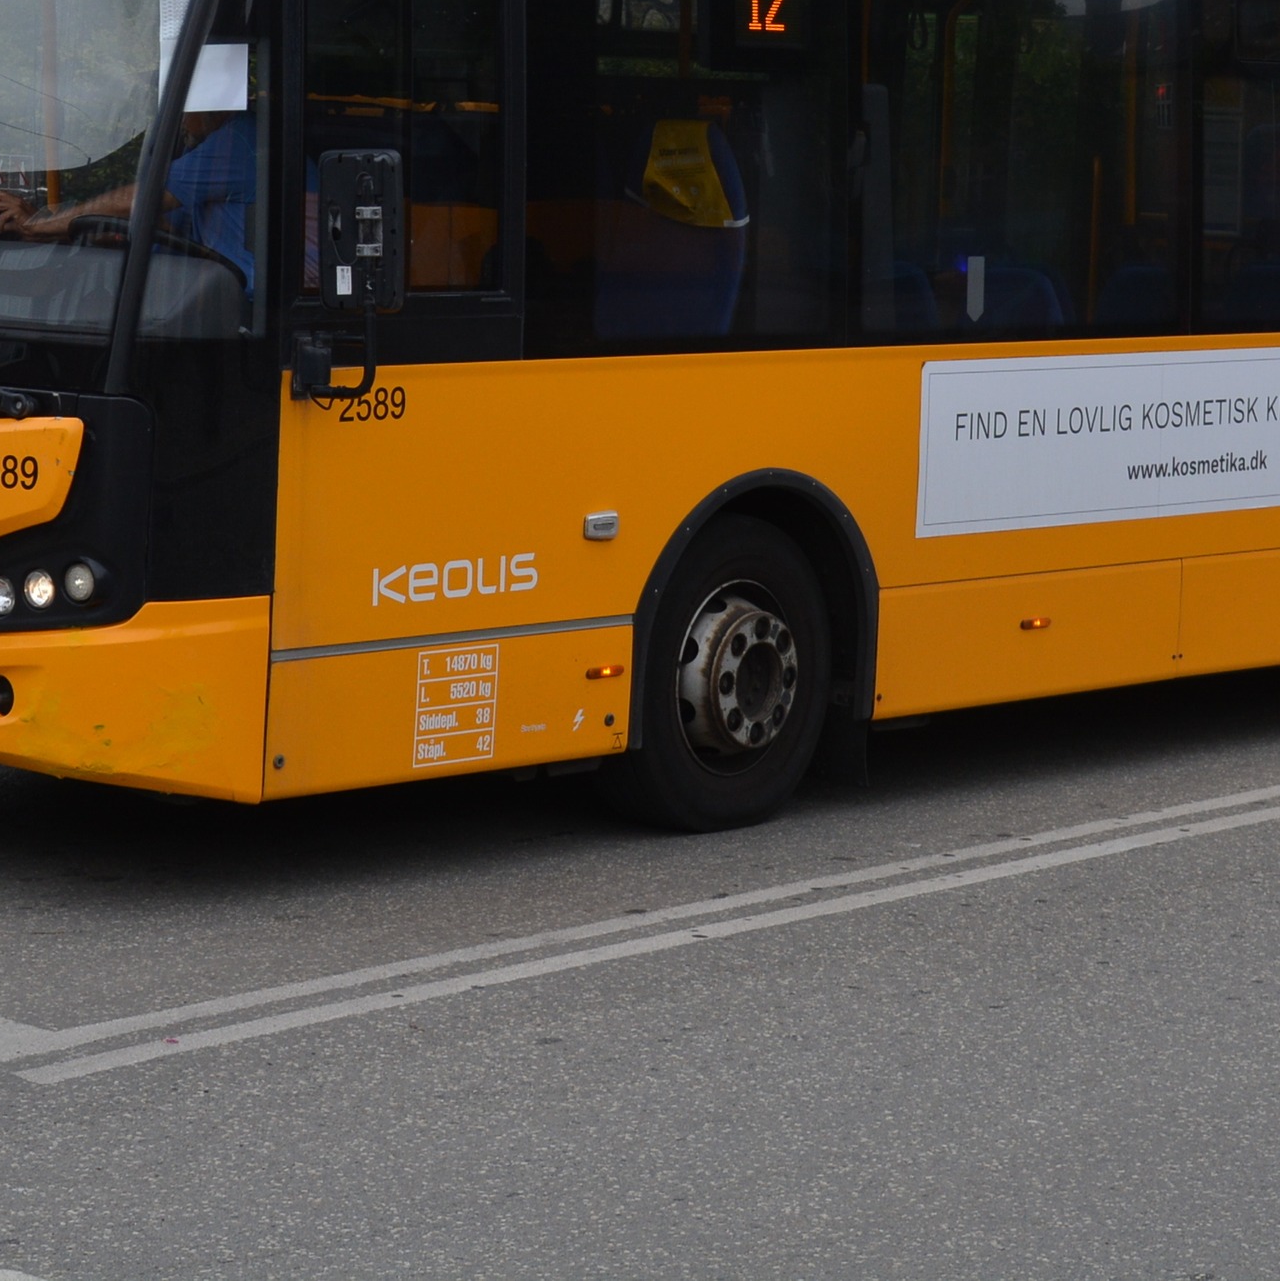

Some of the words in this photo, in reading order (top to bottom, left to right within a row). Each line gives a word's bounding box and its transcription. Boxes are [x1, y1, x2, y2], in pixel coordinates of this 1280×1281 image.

[339, 387, 406, 422] 2589
[955, 411, 1008, 441] FIND
[1018, 409, 1046, 437] EN
[1056, 404, 1132, 435] LOVLIG
[1141, 396, 1259, 430] KOSMETISK
[1127, 450, 1268, 480] www.kosmetika.dk
[423, 658, 431, 675] T.
[445, 653, 478, 672] 14870
[480, 652, 493, 670] kg
[421, 686, 430, 702] L.
[450, 680, 477, 699] 5520
[478, 679, 491, 697] kg
[419, 710, 459, 731] Siddepl.
[476, 707, 490, 724] 38
[417, 738, 447, 761] Ståpl.
[476, 734, 491, 751] 42
